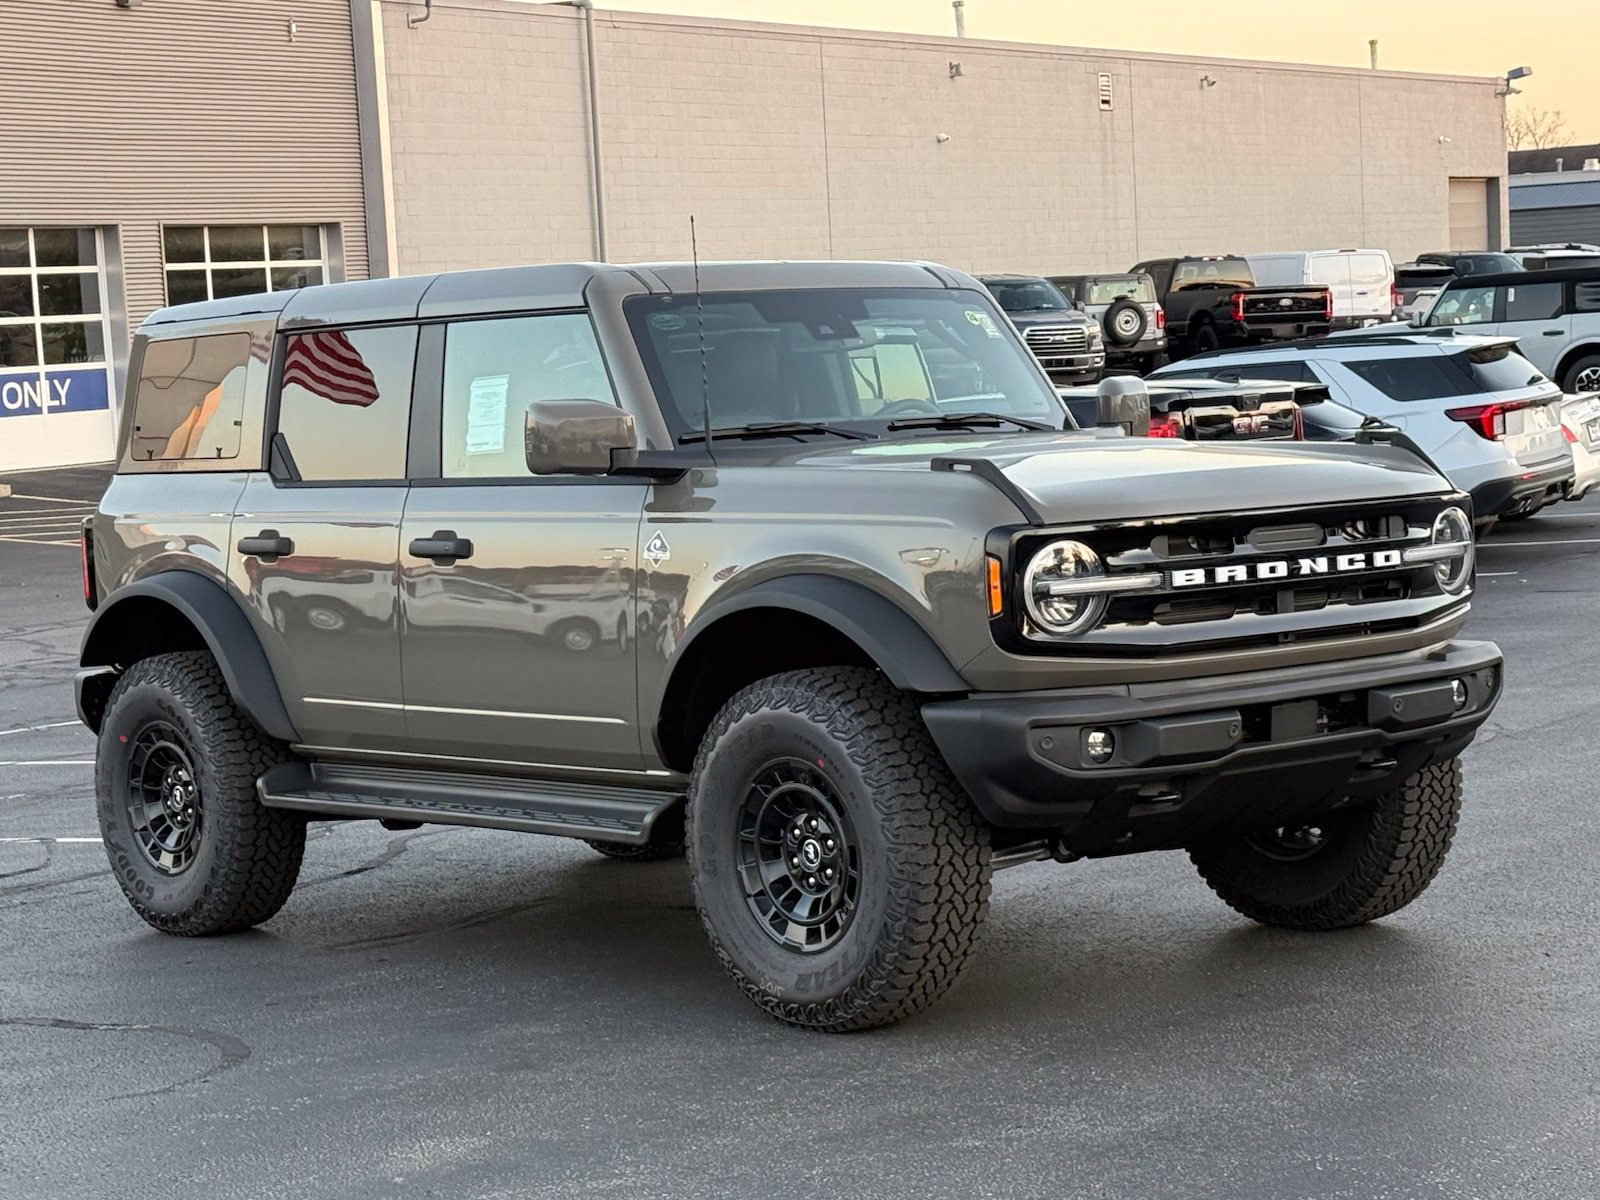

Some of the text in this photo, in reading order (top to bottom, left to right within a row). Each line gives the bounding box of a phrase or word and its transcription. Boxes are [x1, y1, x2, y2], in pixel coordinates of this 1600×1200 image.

[2, 379, 71, 409] ONLY
[1233, 415, 1269, 434] GMC
[1172, 550, 1401, 587] BRONCO
